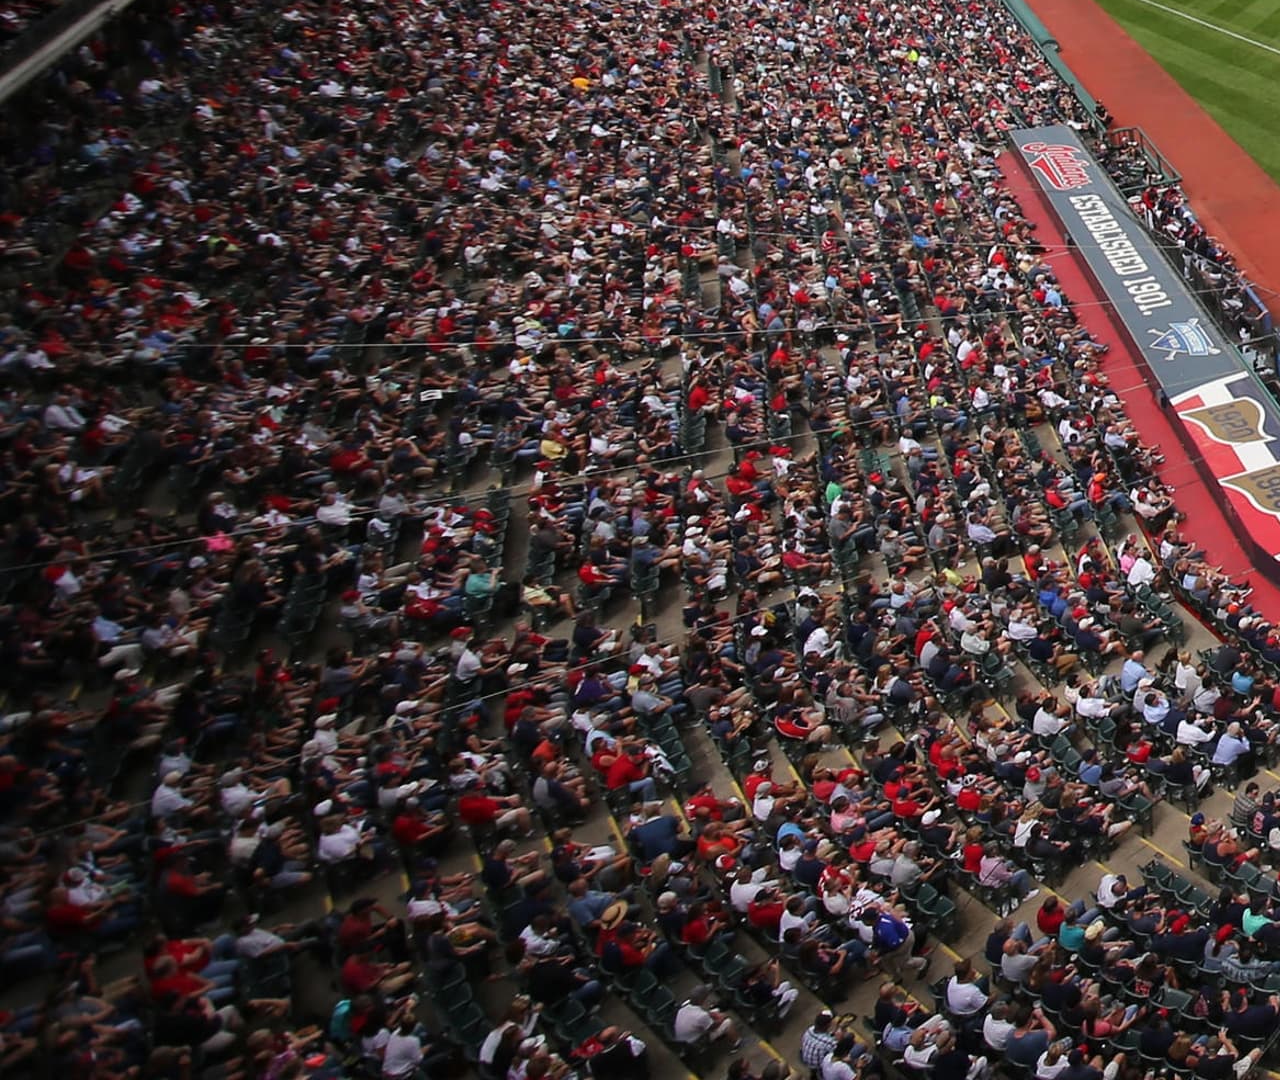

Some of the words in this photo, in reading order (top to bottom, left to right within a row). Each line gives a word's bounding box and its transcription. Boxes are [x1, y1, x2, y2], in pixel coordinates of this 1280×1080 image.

[1020, 142, 1093, 191] Indians
[1068, 194, 1148, 276] ESTABLISHED
[1123, 275, 1172, 316] 1901.
[1207, 403, 1255, 441] 1920
